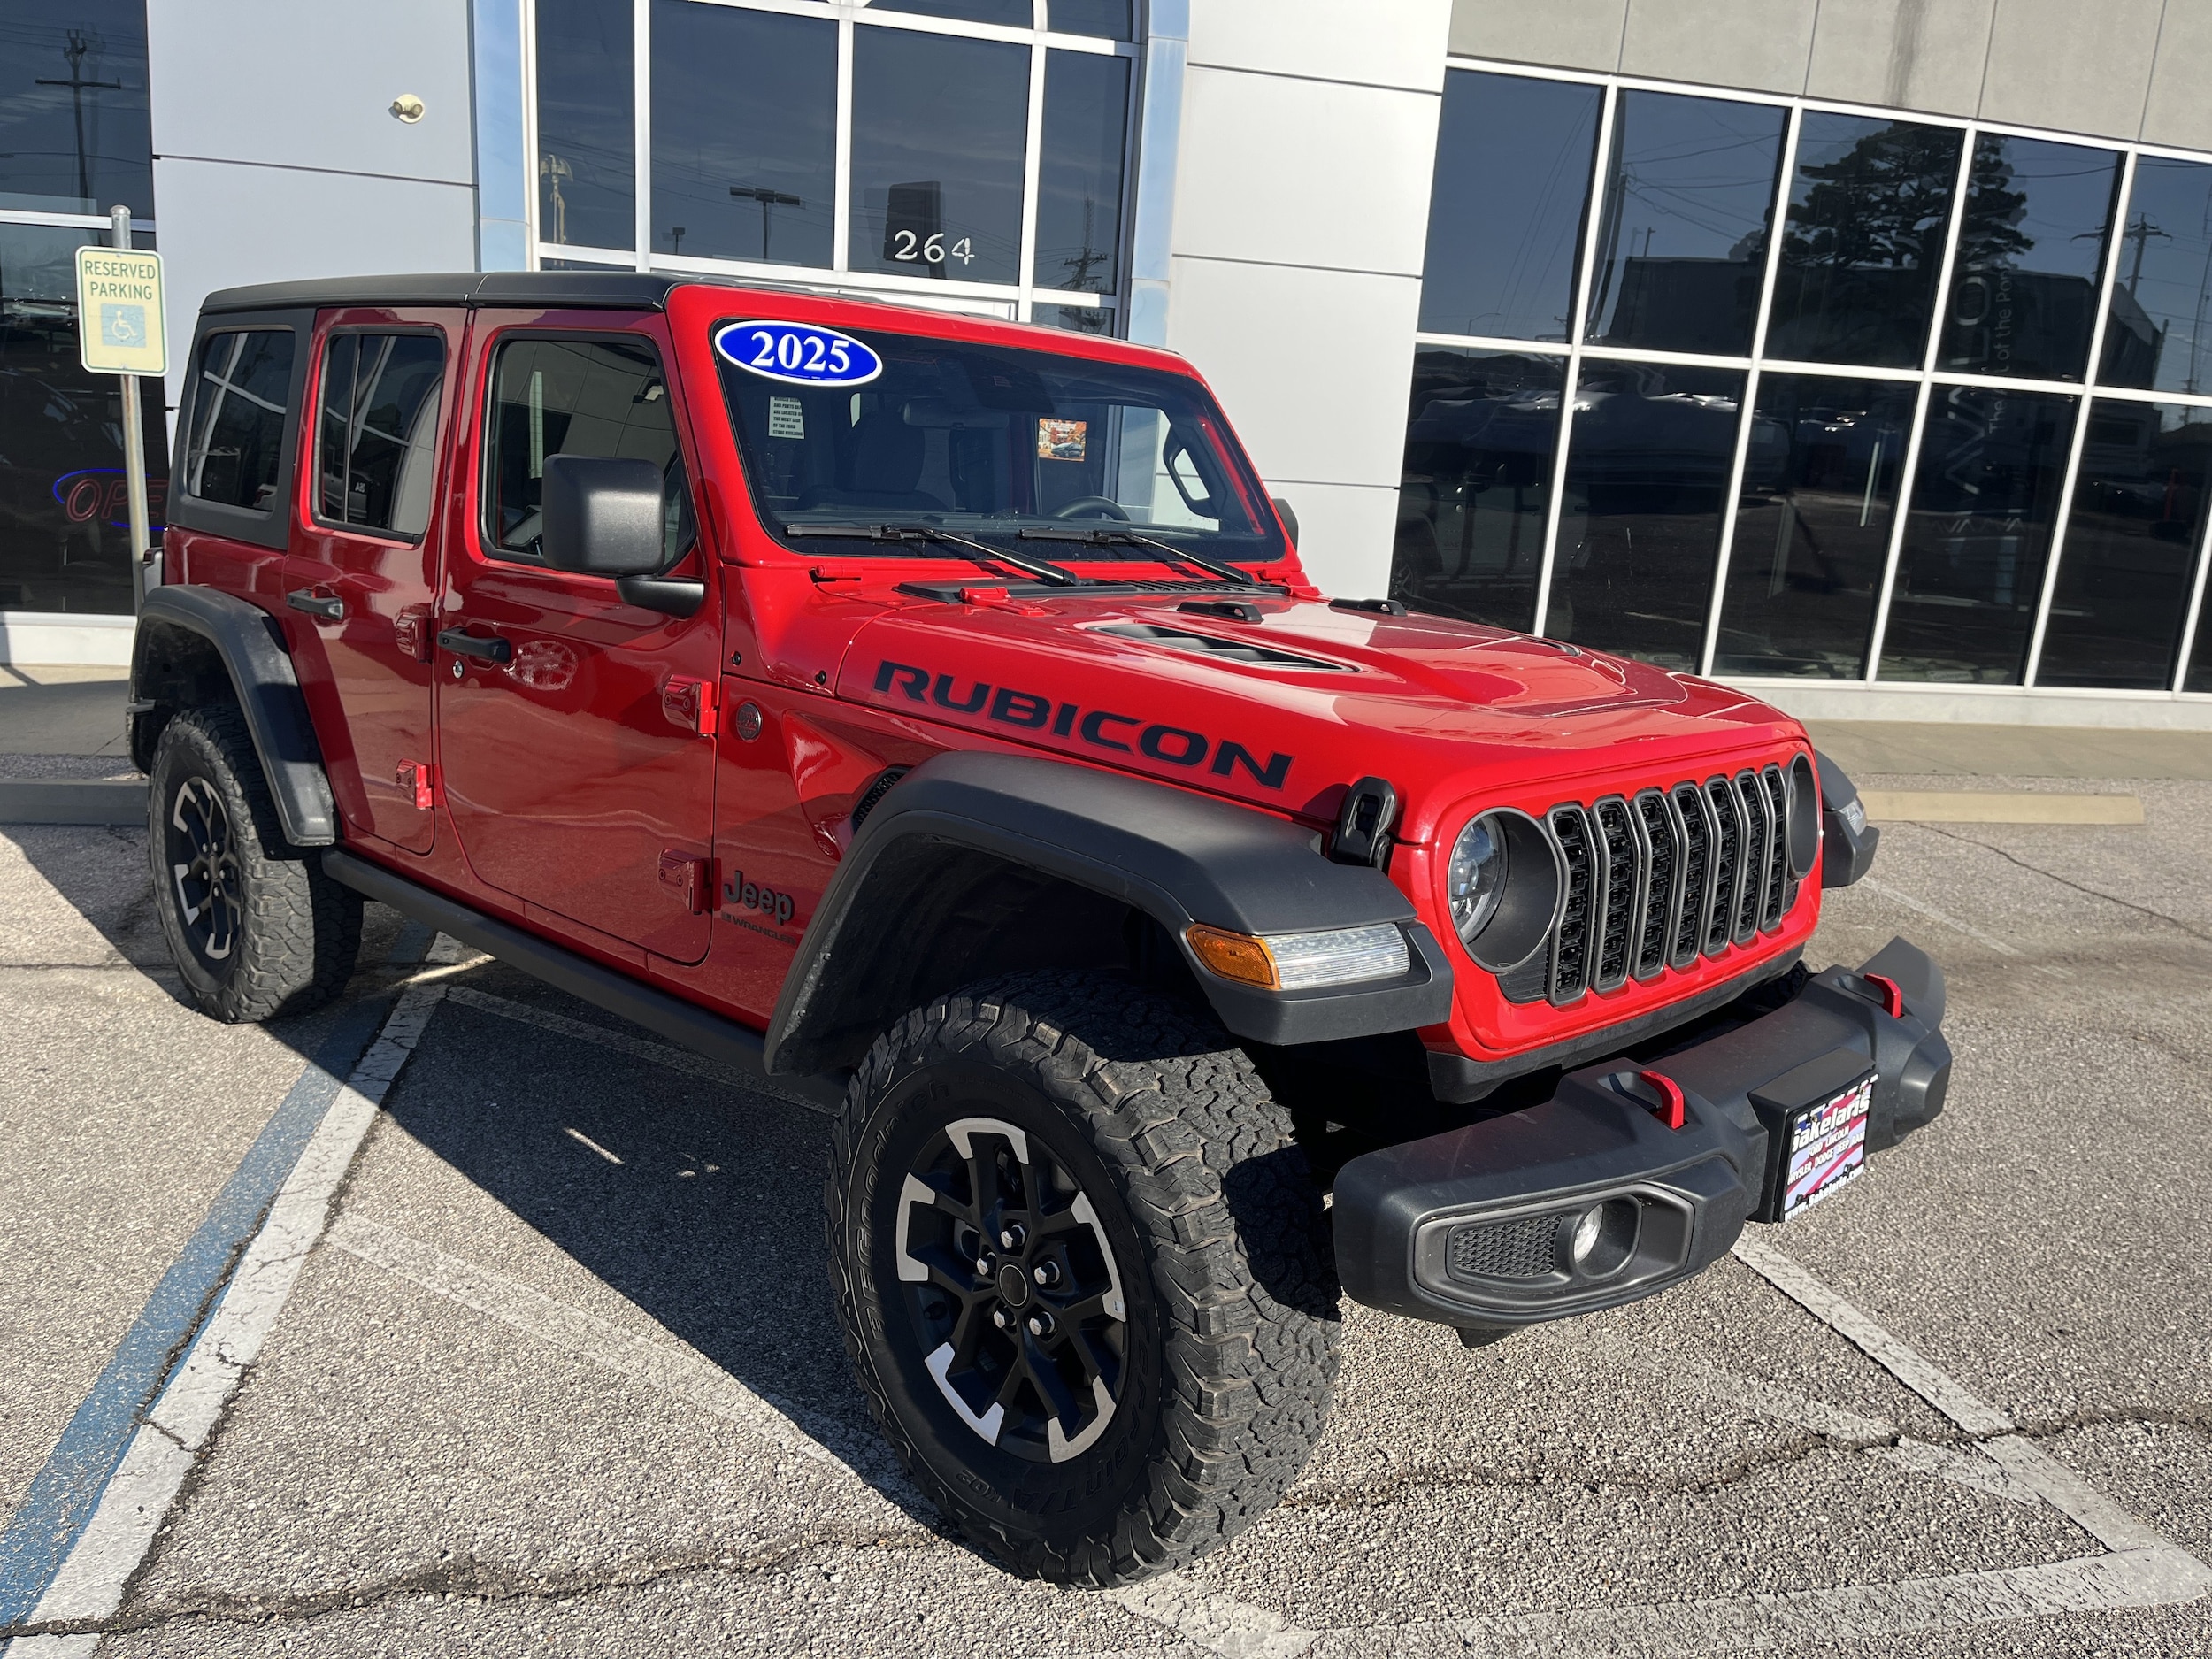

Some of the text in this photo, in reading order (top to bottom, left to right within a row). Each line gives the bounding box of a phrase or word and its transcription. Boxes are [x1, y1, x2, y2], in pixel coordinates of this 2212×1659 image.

[894, 229, 976, 265] 264
[84, 259, 157, 280] RESERVED
[89, 280, 153, 300] PARKING
[1994, 307, 2013, 339] the
[750, 330, 851, 373] 2025
[1993, 342, 2011, 362] of
[66, 478, 169, 523] OPE
[872, 658, 1297, 792] RUBICON
[722, 869, 795, 926] Jeep
[732, 915, 796, 946] WRANGLER
[1787, 1130, 1865, 1186] HRYSLER DODGE JEEP RAM
[1808, 1125, 1850, 1158] FORD LINCOLN
[855, 1079, 950, 1342] BFGoodrich
